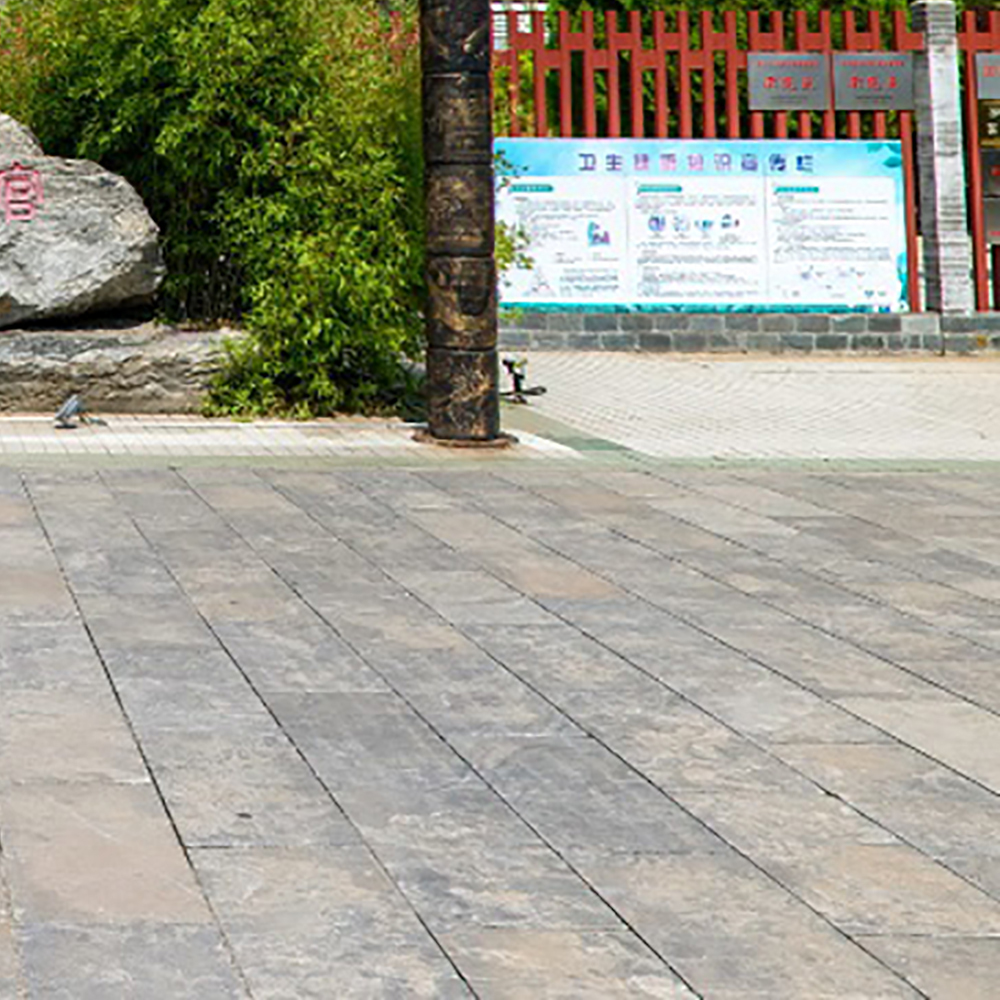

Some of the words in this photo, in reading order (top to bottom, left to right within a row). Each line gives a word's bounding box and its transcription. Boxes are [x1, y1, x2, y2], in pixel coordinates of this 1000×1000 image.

[578, 152, 814, 172] 卫生健康知识宣传栏
